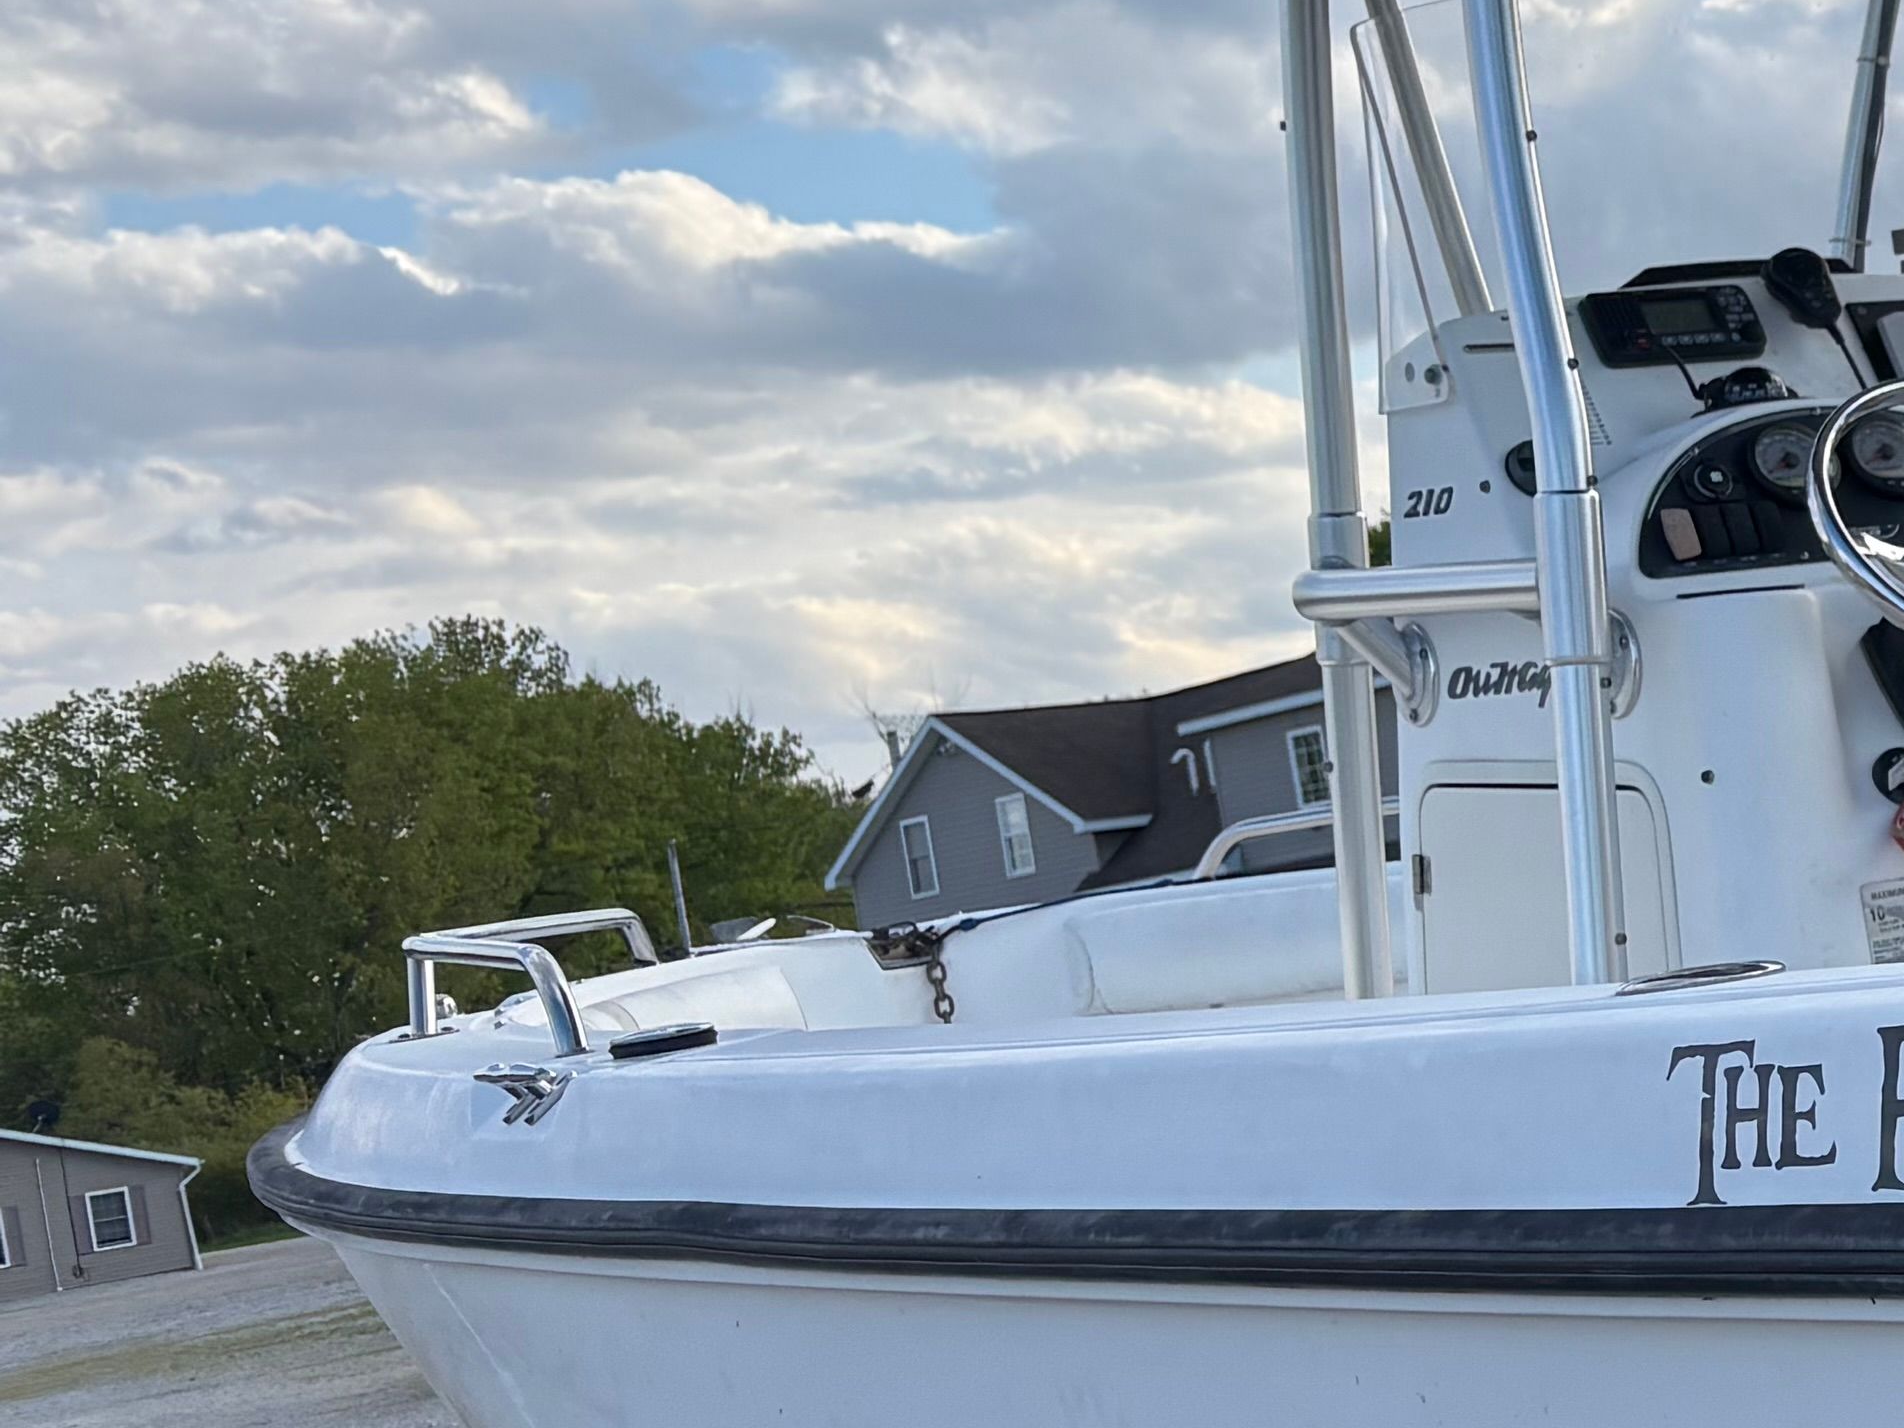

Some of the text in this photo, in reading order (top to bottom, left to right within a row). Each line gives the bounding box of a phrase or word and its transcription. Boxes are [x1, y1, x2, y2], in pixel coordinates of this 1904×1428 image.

[1403, 486, 1453, 518] 210
[1870, 905, 1885, 922] 10
[1667, 1039, 1836, 1206] THE
